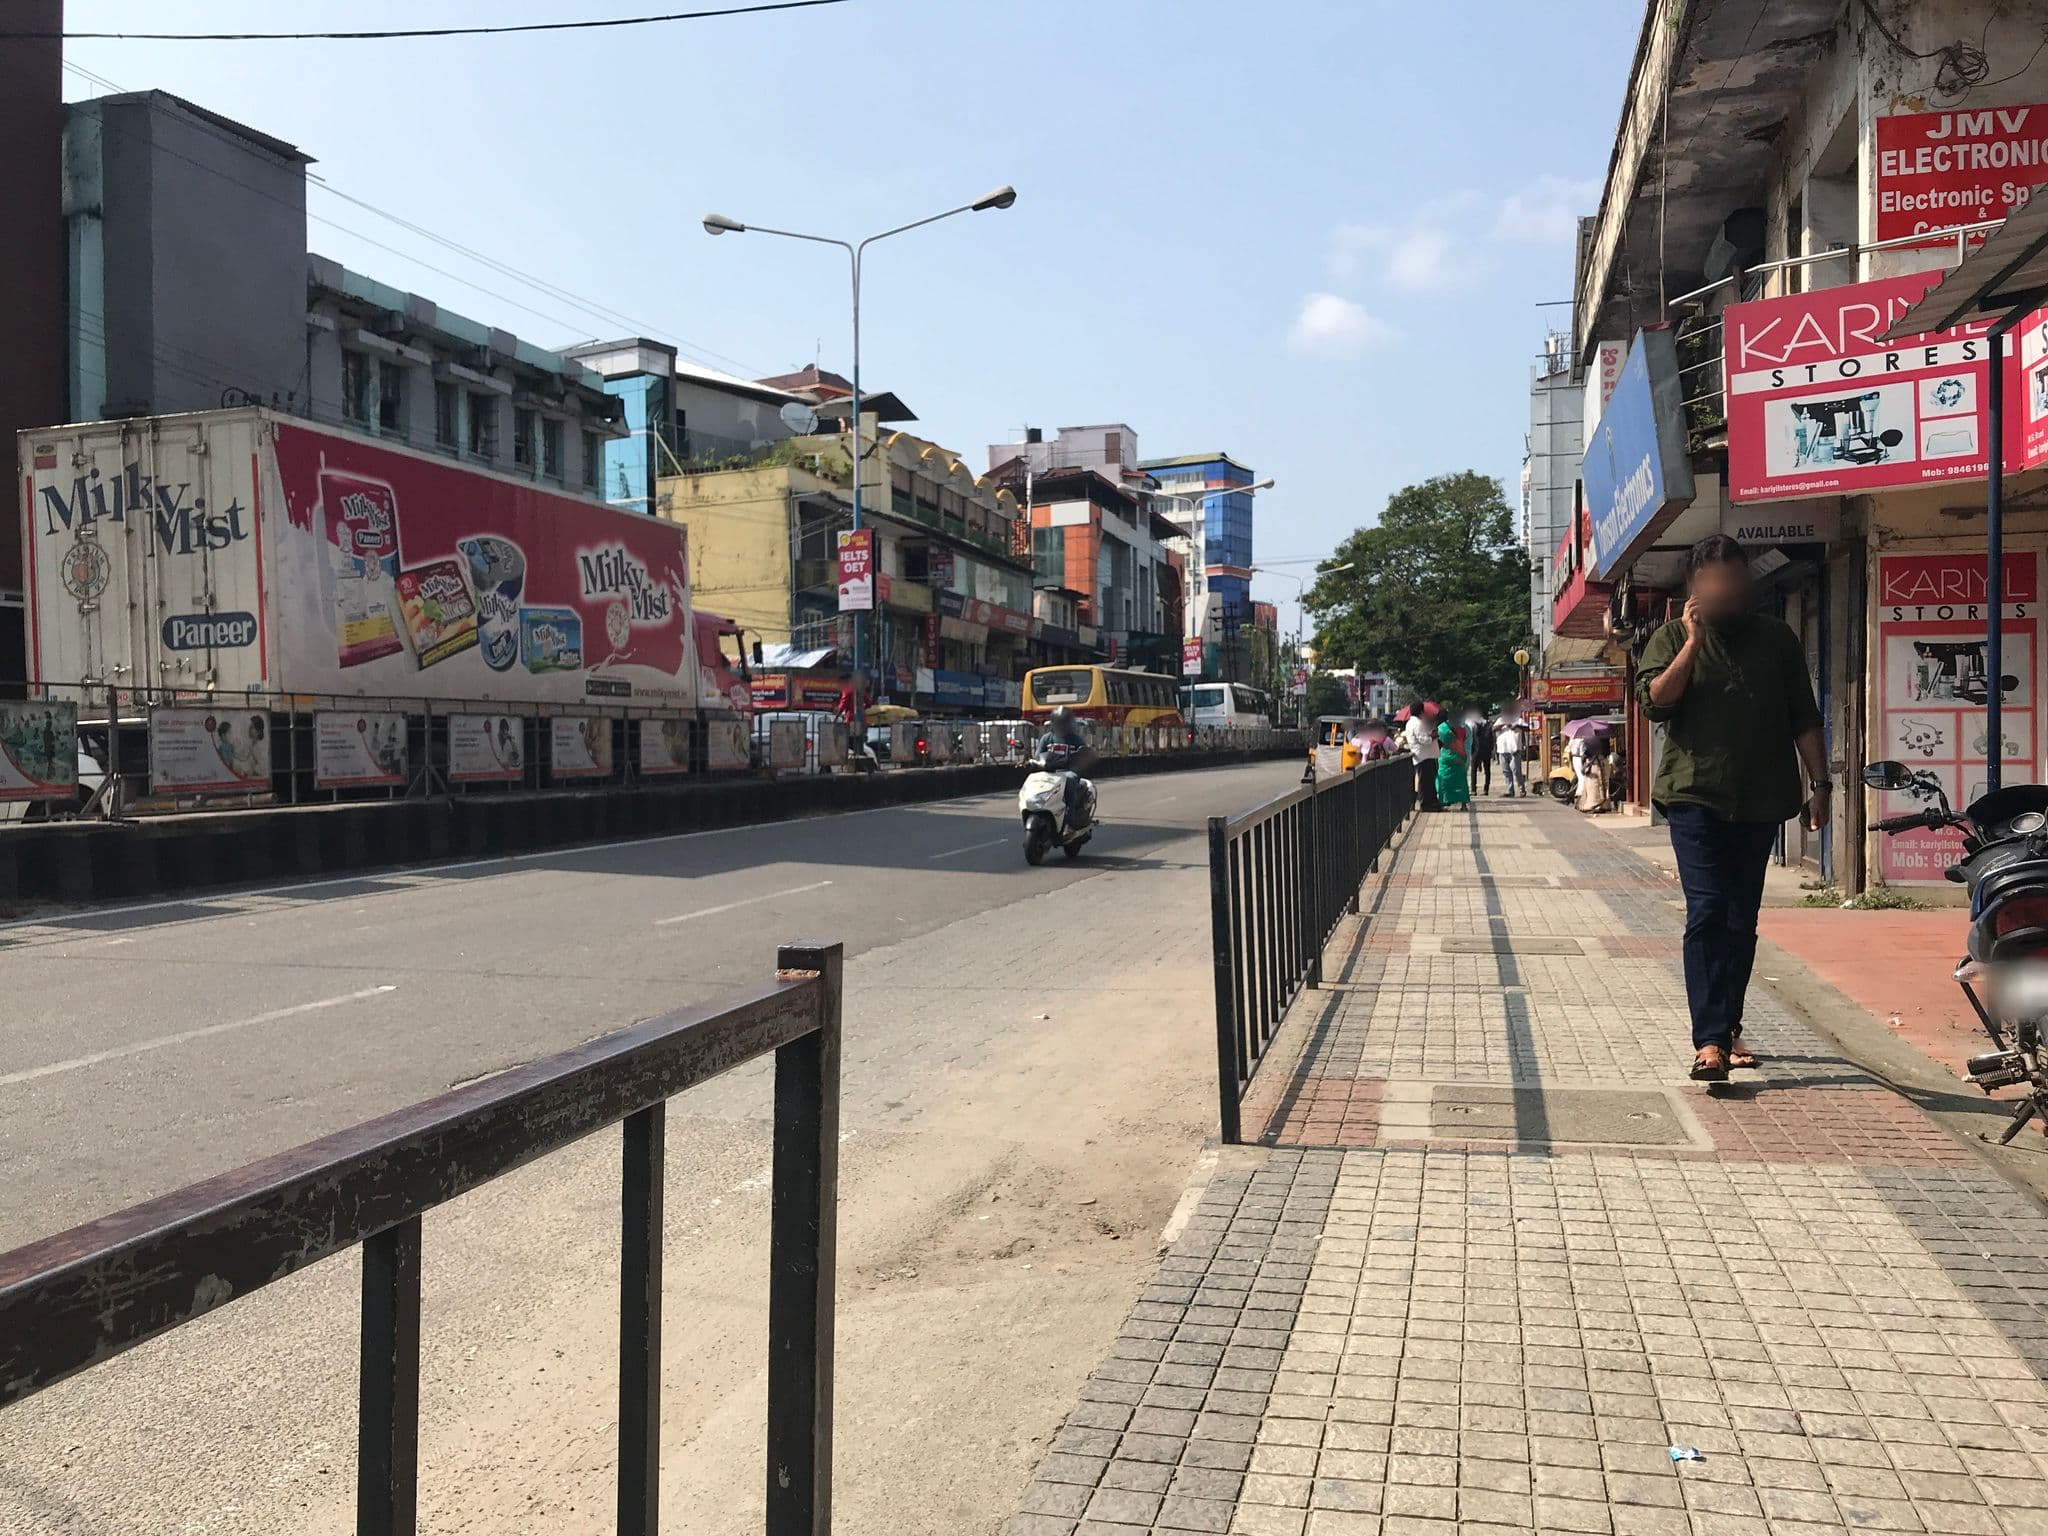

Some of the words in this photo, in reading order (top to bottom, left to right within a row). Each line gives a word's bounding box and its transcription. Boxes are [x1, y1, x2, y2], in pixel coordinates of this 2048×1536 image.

[1926, 109, 2030, 139] JMV
[1881, 184, 1994, 213] Electronic
[1978, 207, 1987, 218] &
[1740, 296, 1990, 369] KARI
[1771, 341, 1977, 388] STORES
[1921, 468, 1945, 478] Mob:
[1739, 487, 1759, 496] Email:
[39, 462, 191, 536] Milky
[148, 497, 248, 558] Mist
[344, 495, 374, 521] Milky
[1737, 524, 1815, 539] AVAILABLE
[840, 550, 869, 562] IELTS
[844, 562, 865, 573] OET
[581, 548, 644, 599] Milky
[631, 583, 669, 621] Mist
[1886, 567, 2029, 600] KARIYL
[1893, 603, 2026, 621] STORS
[172, 618, 253, 648] Paneer
[1891, 839, 1918, 849] Email:
[1891, 852, 1929, 867] Mob:
